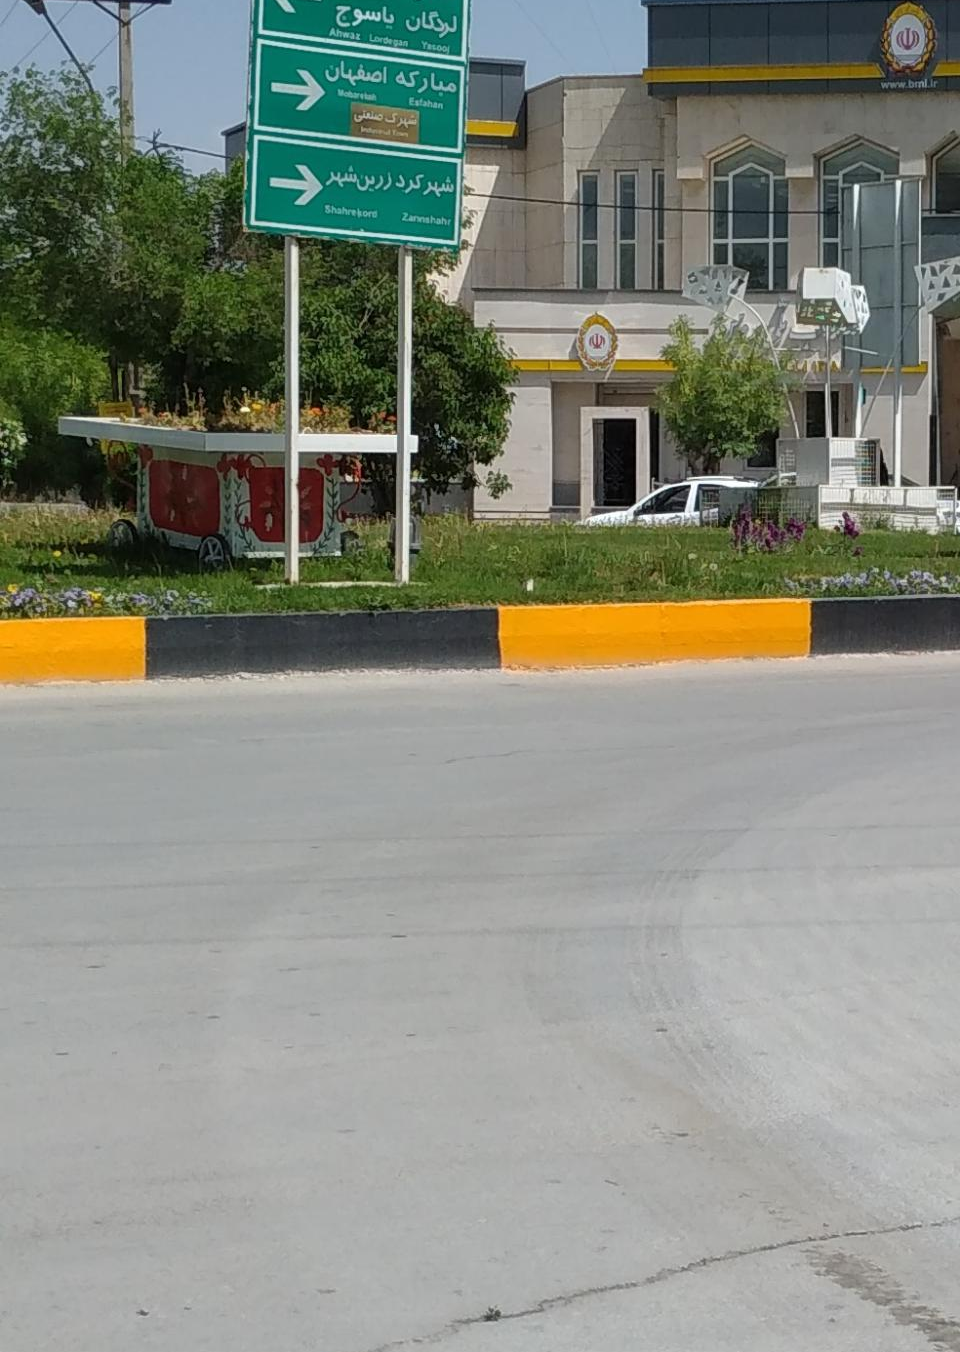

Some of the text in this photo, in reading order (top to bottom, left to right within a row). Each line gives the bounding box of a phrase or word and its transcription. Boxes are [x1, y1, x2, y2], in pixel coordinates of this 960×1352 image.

[335, 5, 458, 39] لردگان یاسوج
[328, 27, 451, 55] Ahwaz Lordegan Yasooj
[324, 59, 457, 97] مبارکه اصفهان
[880, 78, 939, 90] www.bml.ir
[408, 96, 444, 110] Esfahan
[353, 109, 418, 129] شهرک صنعتی
[324, 204, 379, 219] Shahrekord
